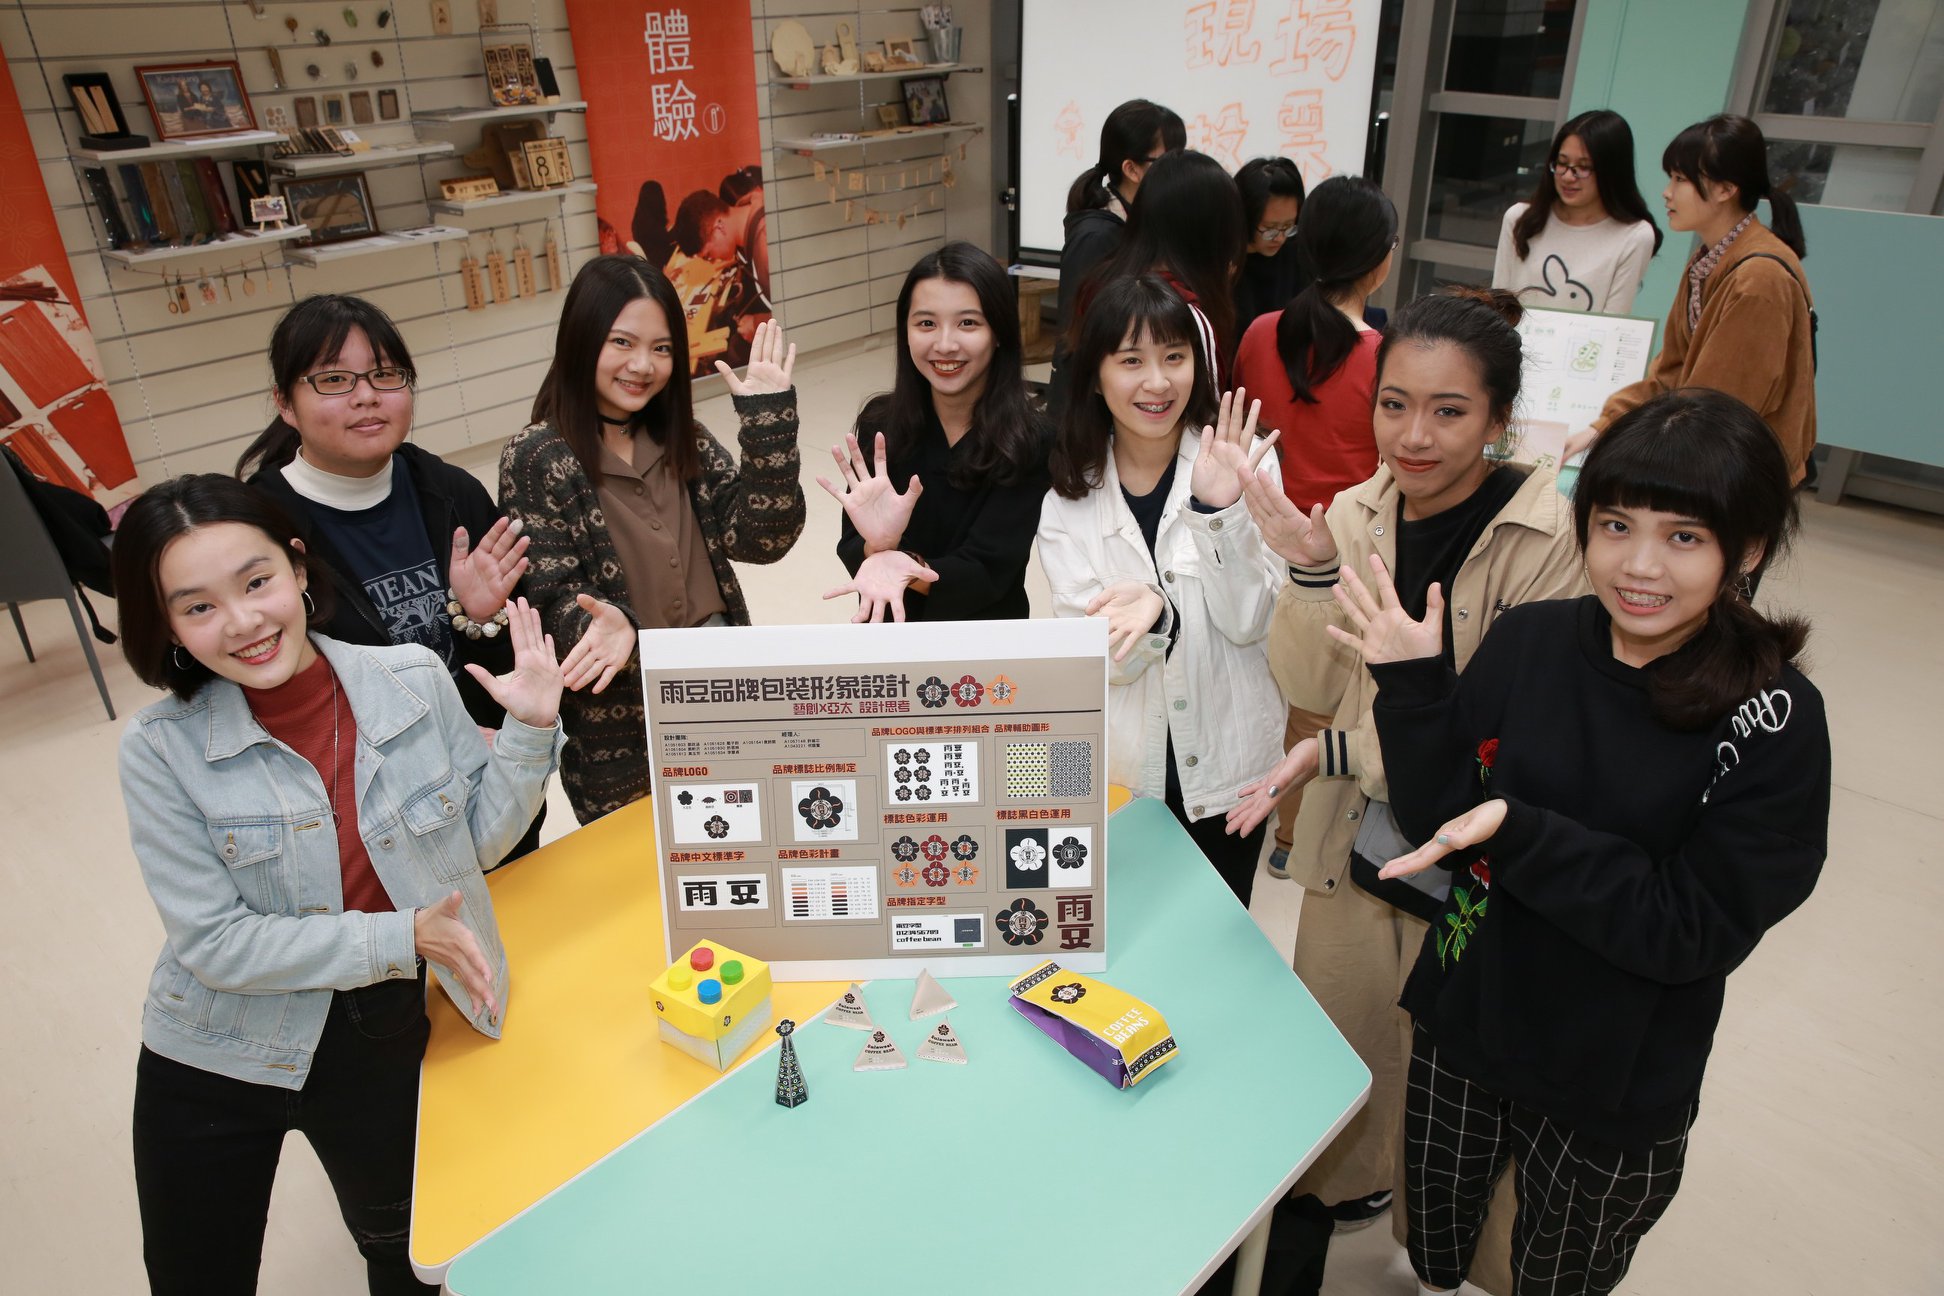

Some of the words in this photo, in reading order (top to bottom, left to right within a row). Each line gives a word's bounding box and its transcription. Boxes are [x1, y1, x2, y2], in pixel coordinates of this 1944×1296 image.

[644, 9, 700, 142] 體驗
[660, 674, 910, 704] 雨豆品牌包裝形象設計
[859, 700, 910, 713] 設計思考
[994, 723, 1050, 733] 品牌輔助圖形
[663, 767, 708, 777] 品牌LOGO
[772, 763, 857, 775] 品牌標誌比例制定
[883, 813, 948, 824] 標誌色彩運用
[996, 808, 1071, 820] 標誌黑白色運用
[670, 852, 745, 862] 品牌中文標準字
[887, 896, 946, 907] 品牌指定字型
[1056, 894, 1094, 950] 雨豆
[1103, 1007, 1143, 1037] COFFEE
[1113, 1016, 1149, 1044] BEANS
